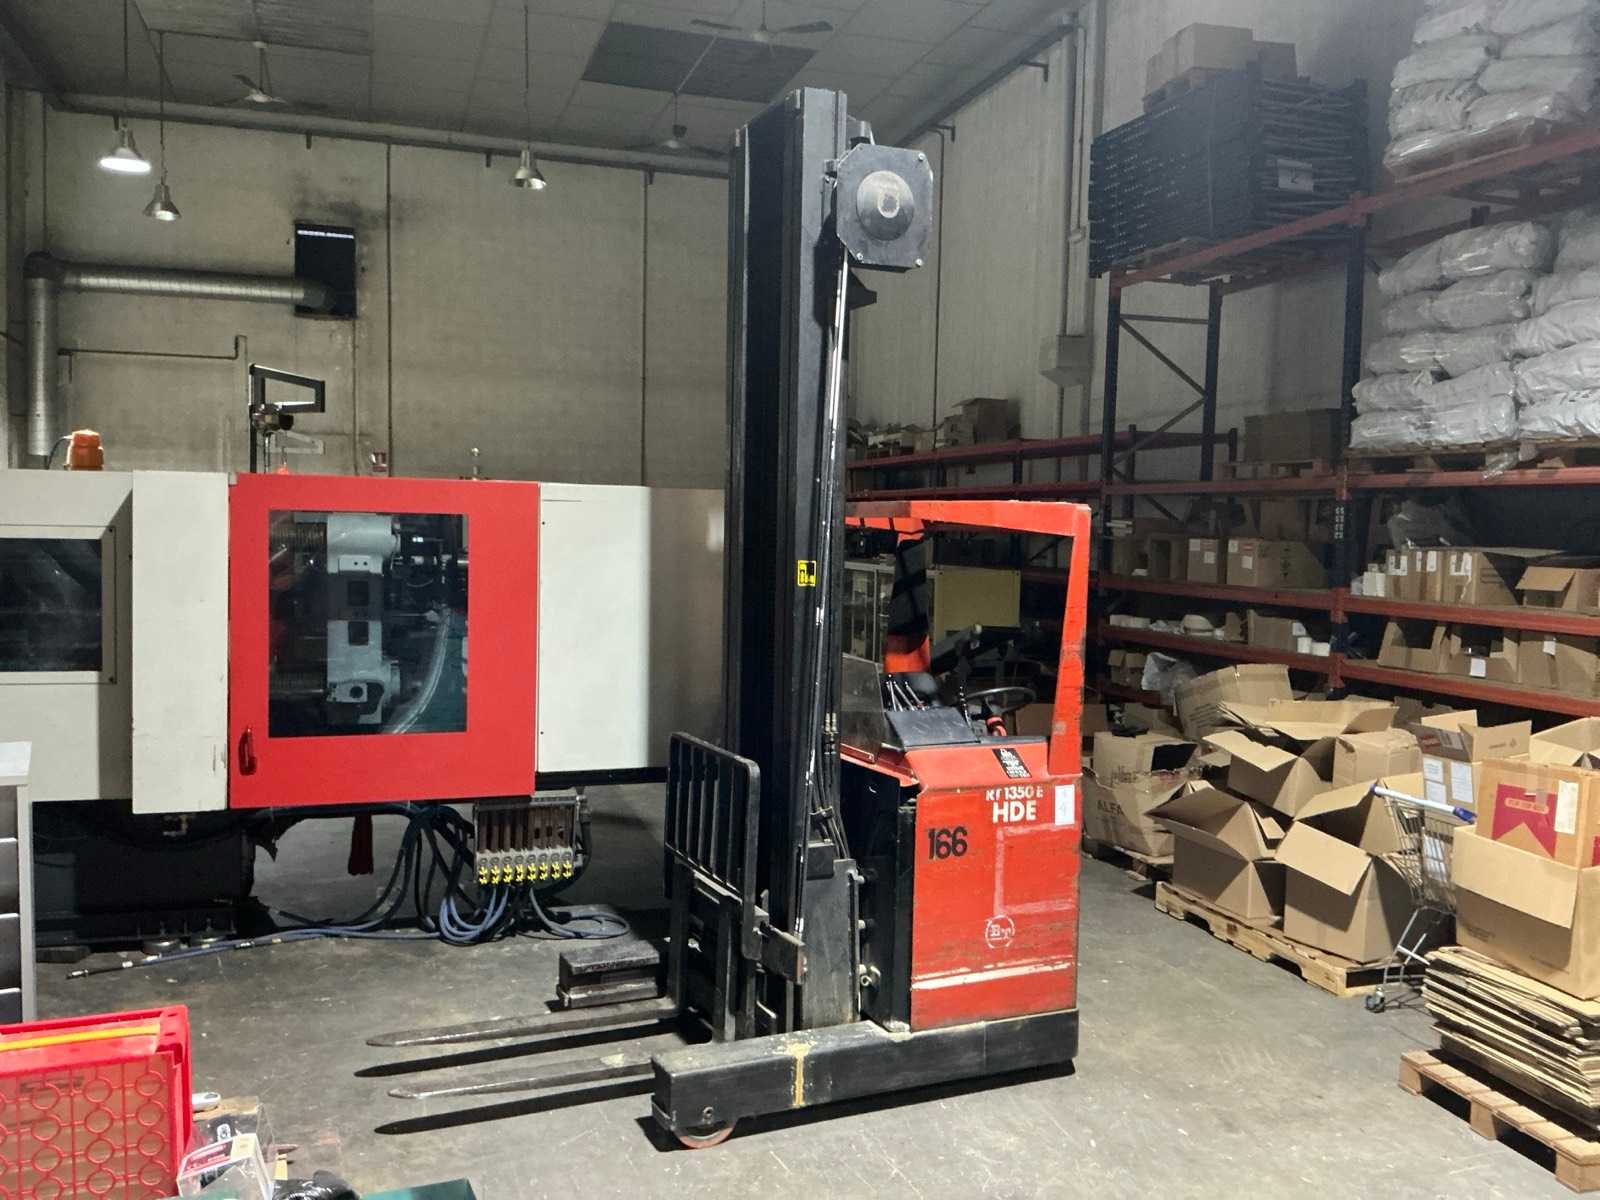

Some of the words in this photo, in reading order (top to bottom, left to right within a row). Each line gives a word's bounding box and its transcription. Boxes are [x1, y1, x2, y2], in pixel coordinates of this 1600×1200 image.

[1004, 785, 1035, 800] 1350
[992, 800, 1037, 824] HDE
[928, 826, 968, 860] 166
